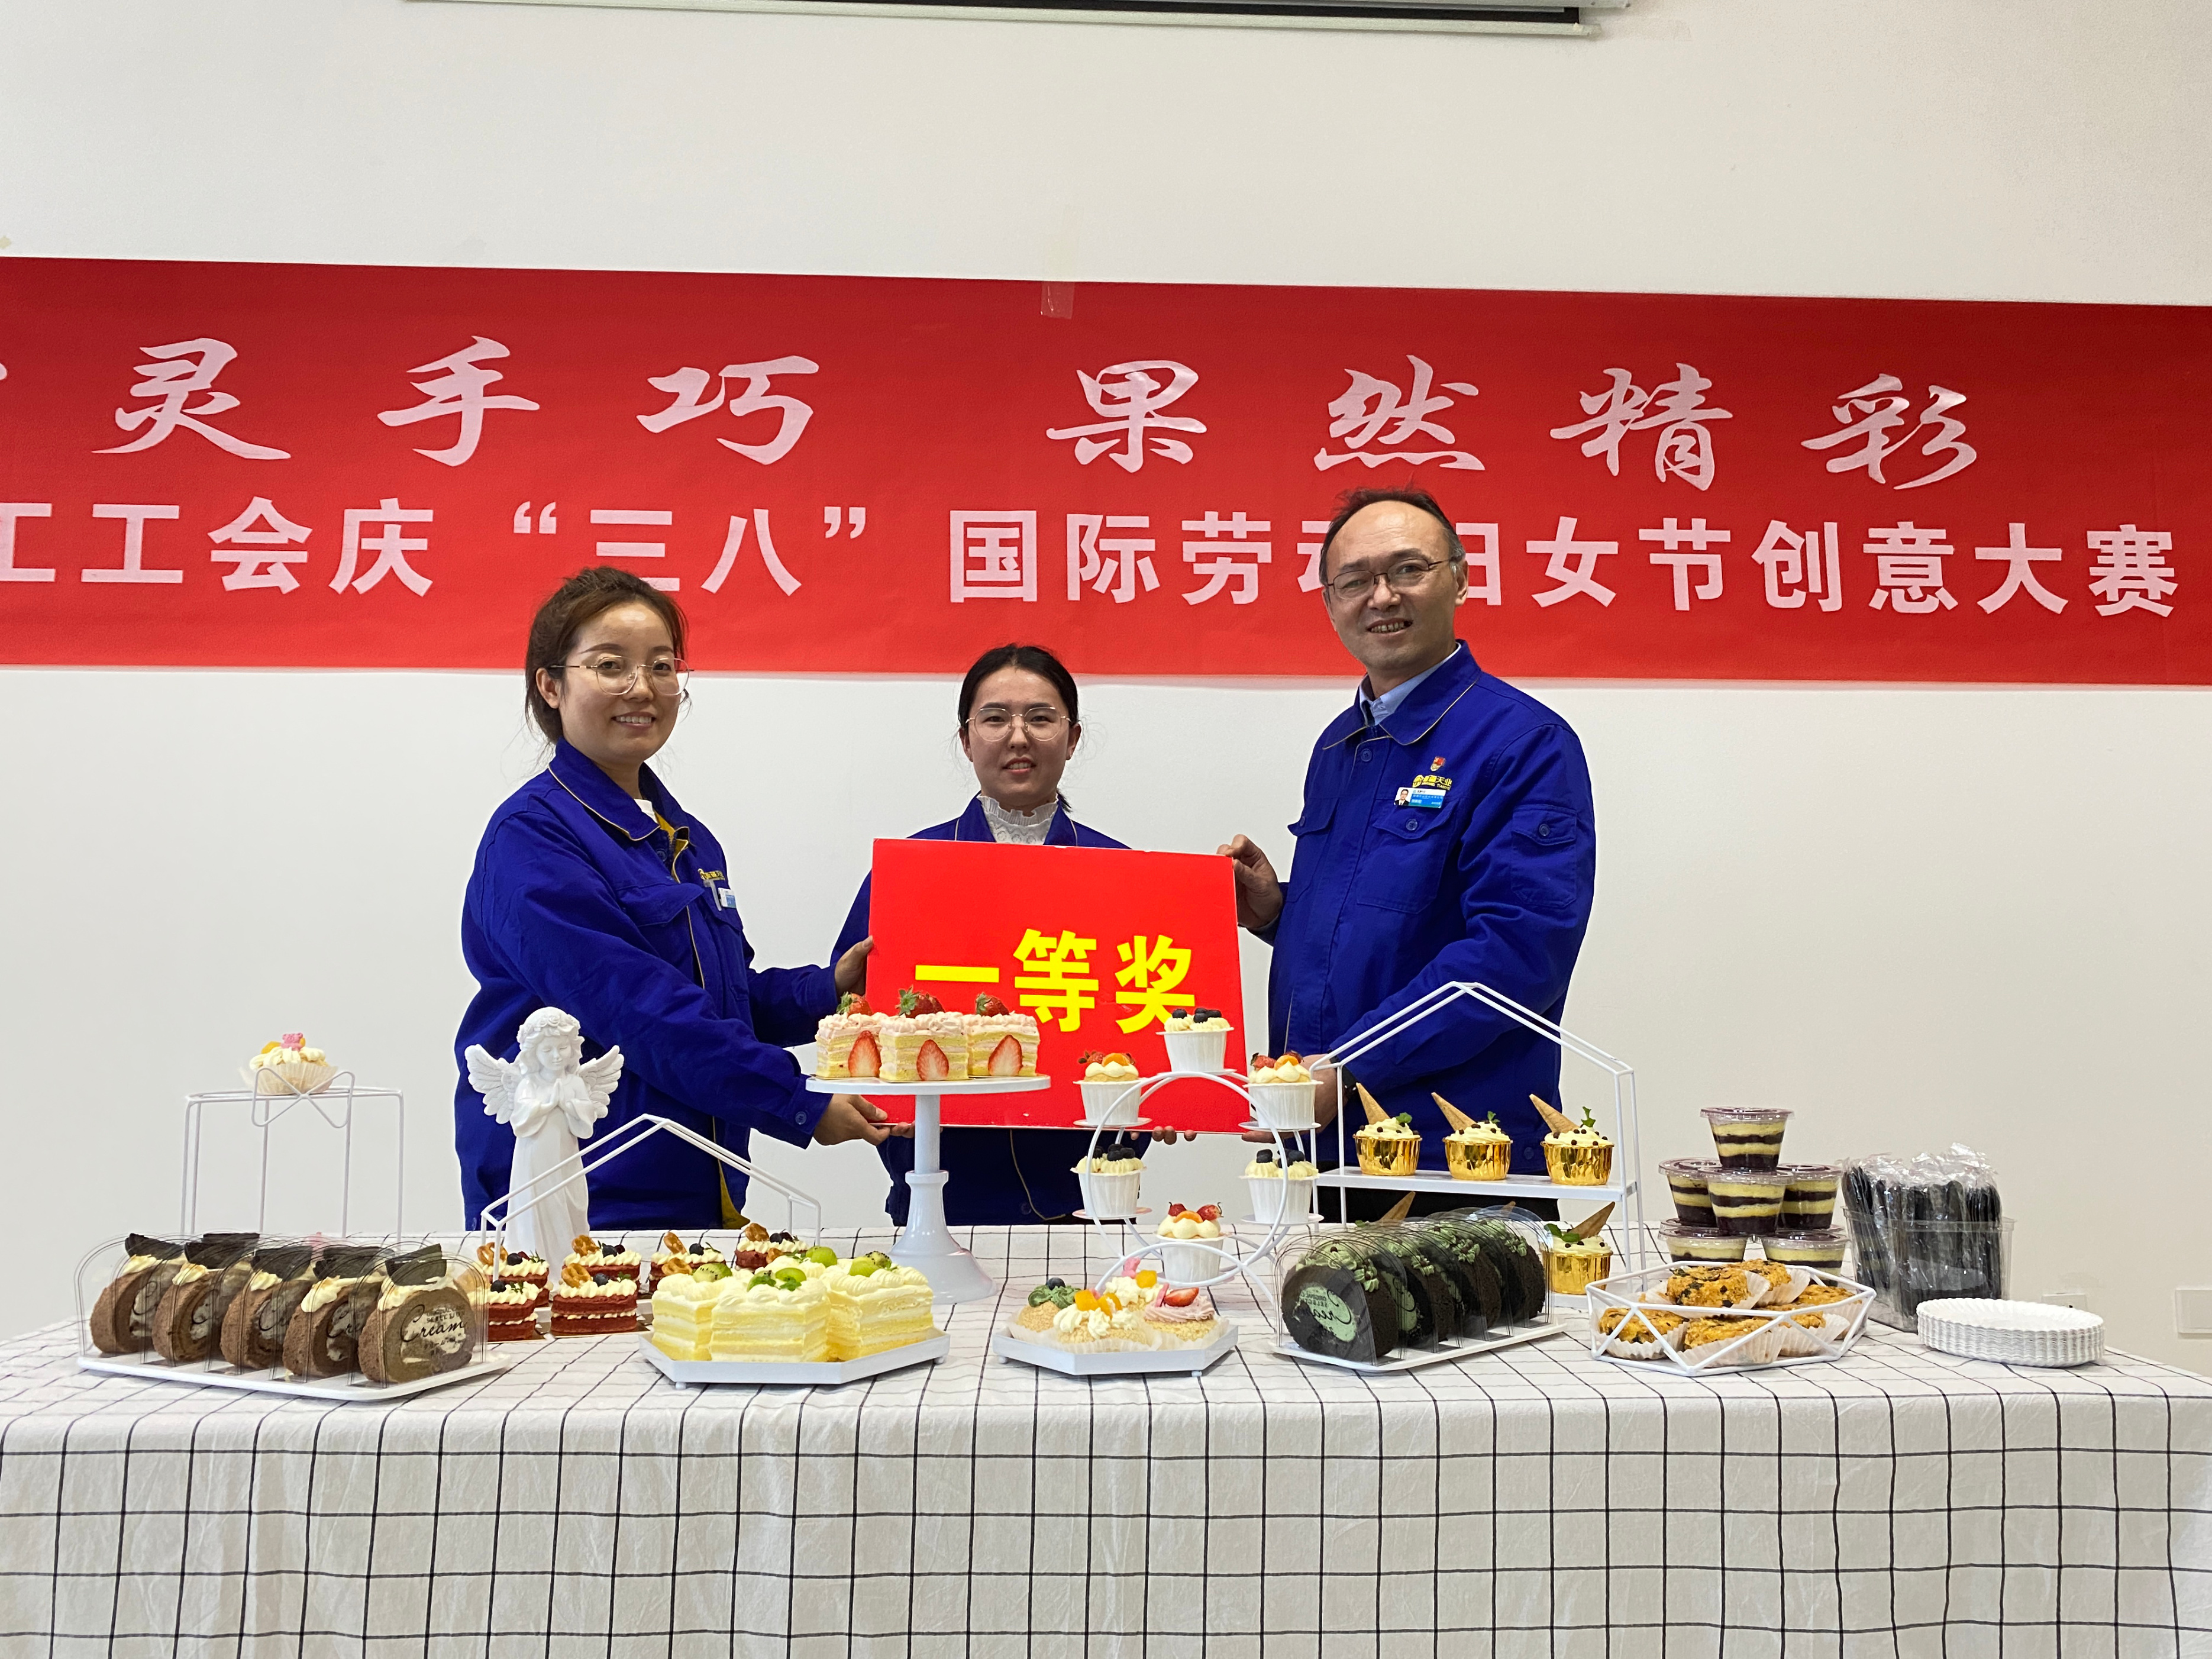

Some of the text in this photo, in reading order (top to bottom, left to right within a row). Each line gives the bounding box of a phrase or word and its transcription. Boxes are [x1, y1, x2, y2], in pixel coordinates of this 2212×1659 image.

[0, 335, 1977, 491] 灵手巧 果然精彩
[915, 928, 1195, 1034] 一等奖
[400, 1303, 467, 1342] Cream
